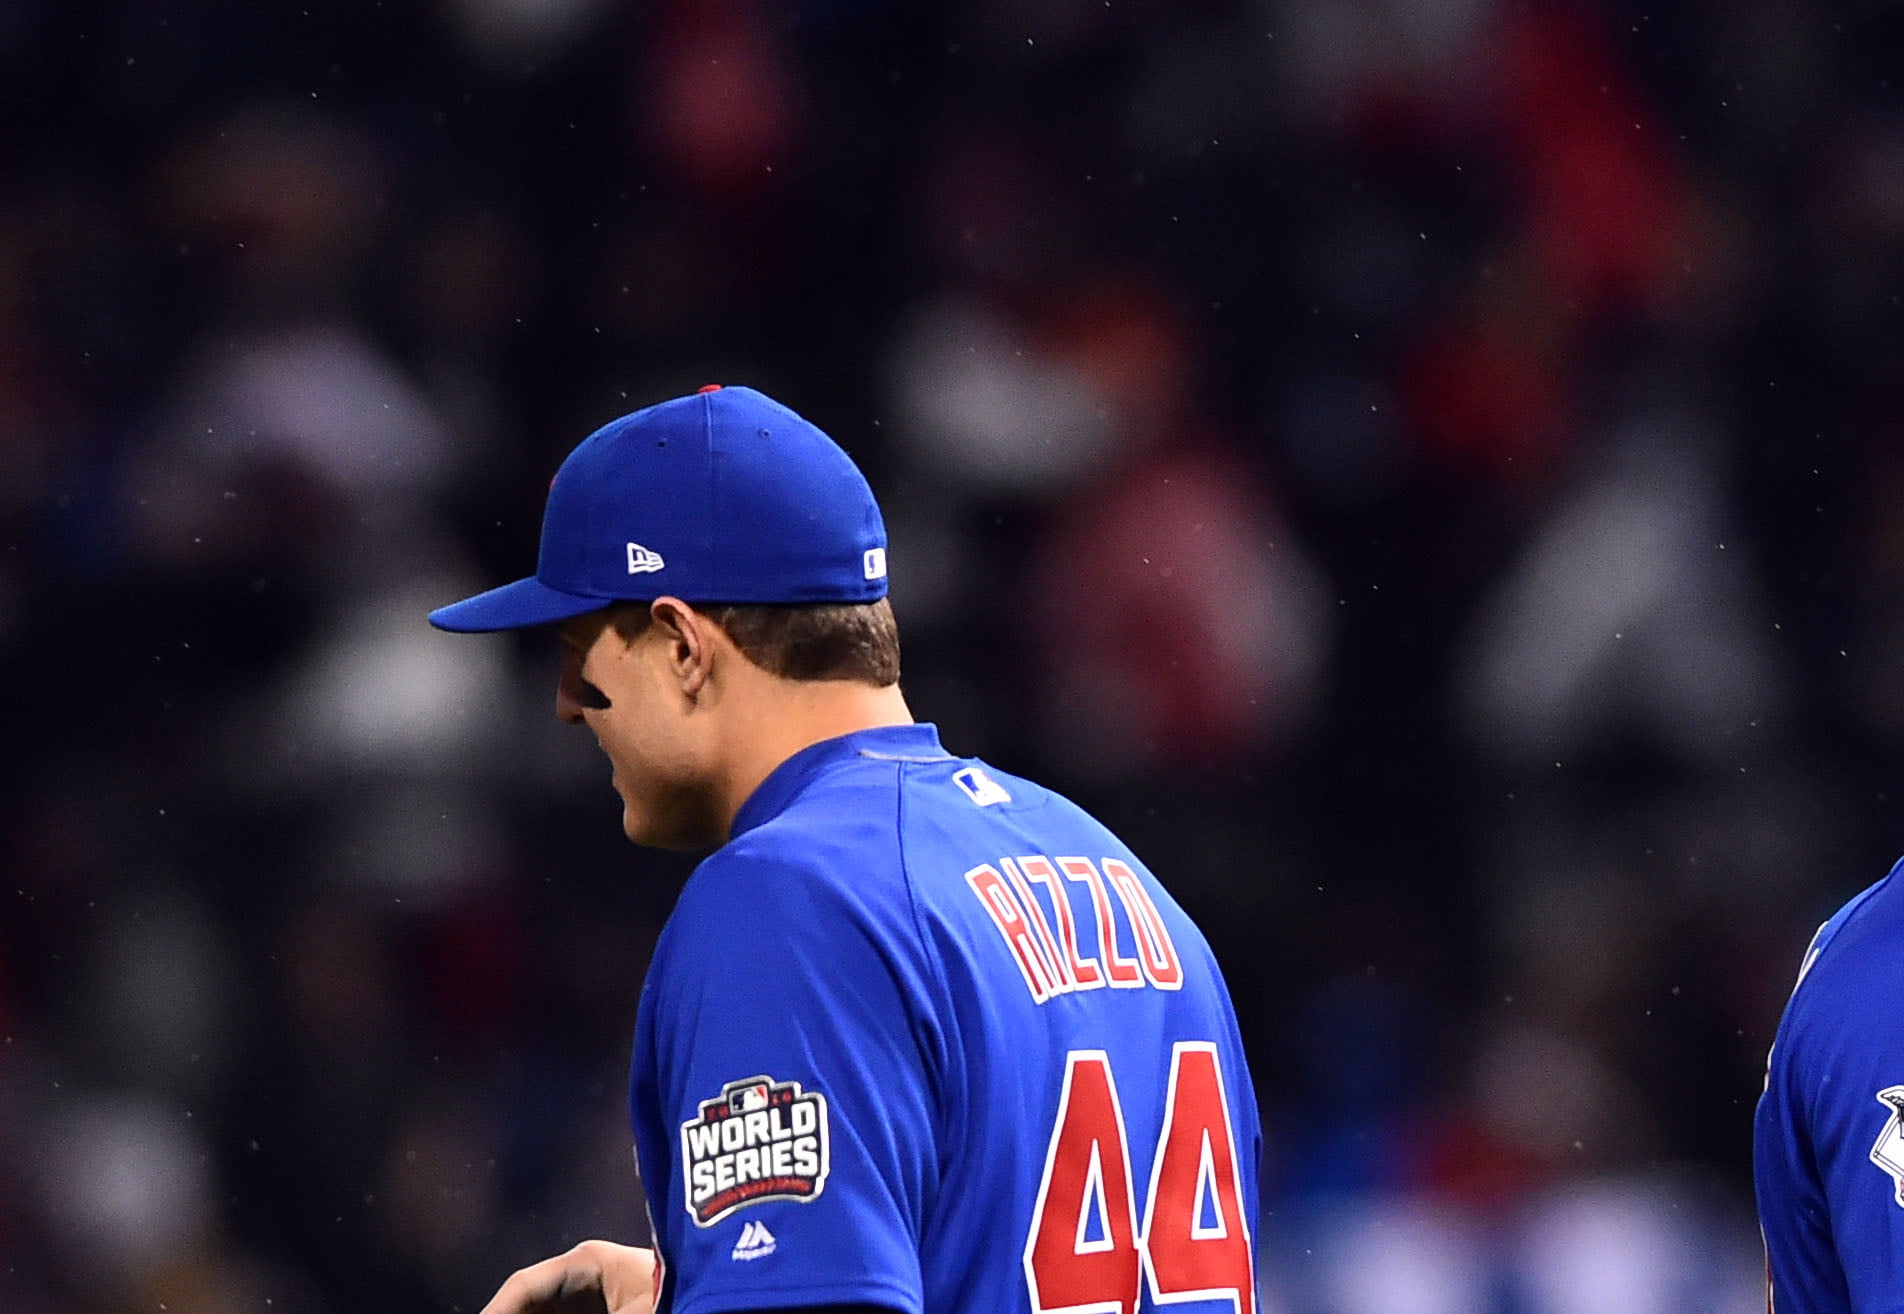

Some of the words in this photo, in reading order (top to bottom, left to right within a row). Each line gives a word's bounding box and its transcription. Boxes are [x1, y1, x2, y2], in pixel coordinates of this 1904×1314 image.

[965, 855, 1184, 1006] RIZZO
[689, 1101, 817, 1160] WORLD
[693, 1136, 818, 1203] SERIES
